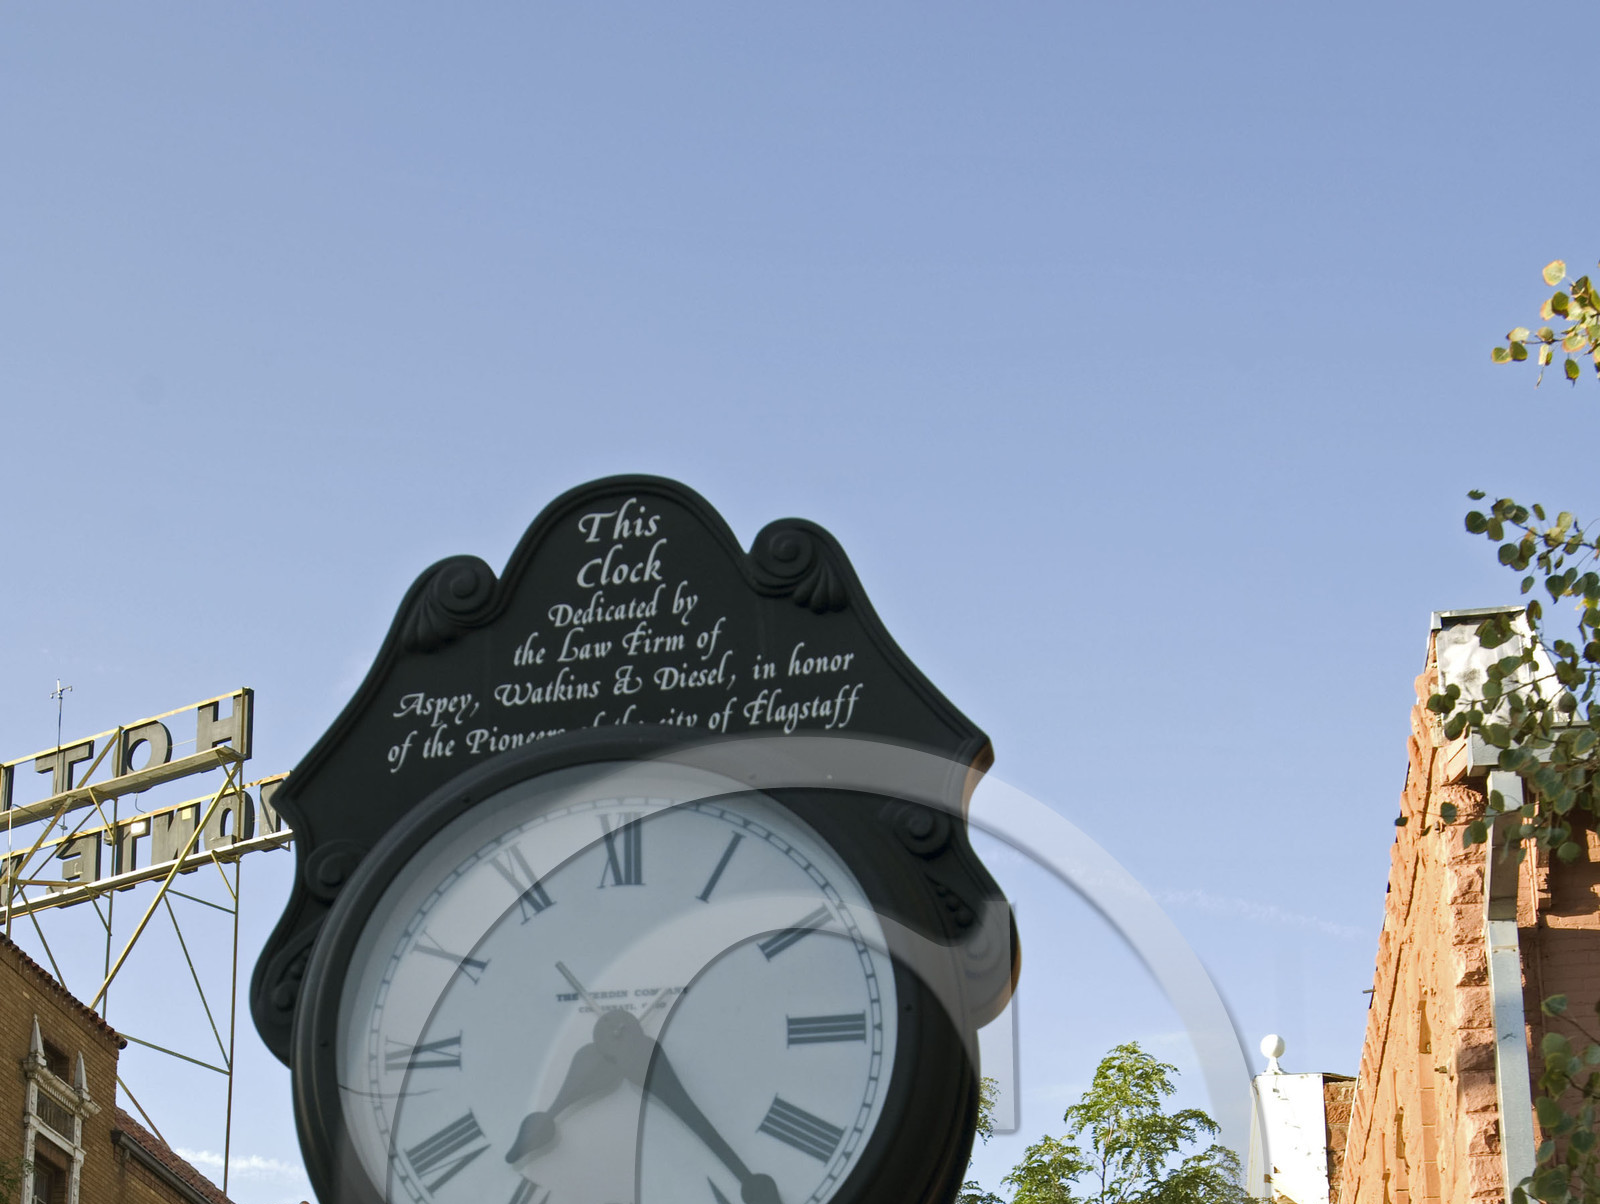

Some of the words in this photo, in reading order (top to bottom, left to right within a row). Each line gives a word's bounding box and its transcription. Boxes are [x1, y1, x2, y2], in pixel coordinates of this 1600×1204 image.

[578, 497, 661, 543] This
[576, 538, 667, 588] Clock
[548, 584, 666, 627] Dedicated
[672, 580, 698, 626] by
[513, 632, 546, 666] the
[557, 627, 612, 662] Law
[622, 621, 685, 656] Firm
[696, 617, 726, 661] of
[393, 692, 480, 727] Aspey,
[494, 667, 602, 707] Watkins
[613, 665, 643, 695] &
[653, 650, 737, 691] Diesel,
[752, 655, 776, 681] in
[788, 643, 855, 676] honor
[387, 731, 418, 773] of
[422, 724, 455, 759] the
[708, 697, 738, 733] of
[743, 683, 864, 735] Flagstaff
[597, 812, 645, 888] XII
[487, 843, 556, 925] XI
[410, 931, 490, 984] X
[785, 1011, 867, 1049] III
[403, 1108, 492, 1195] VIII
[757, 1093, 846, 1166] IIII
